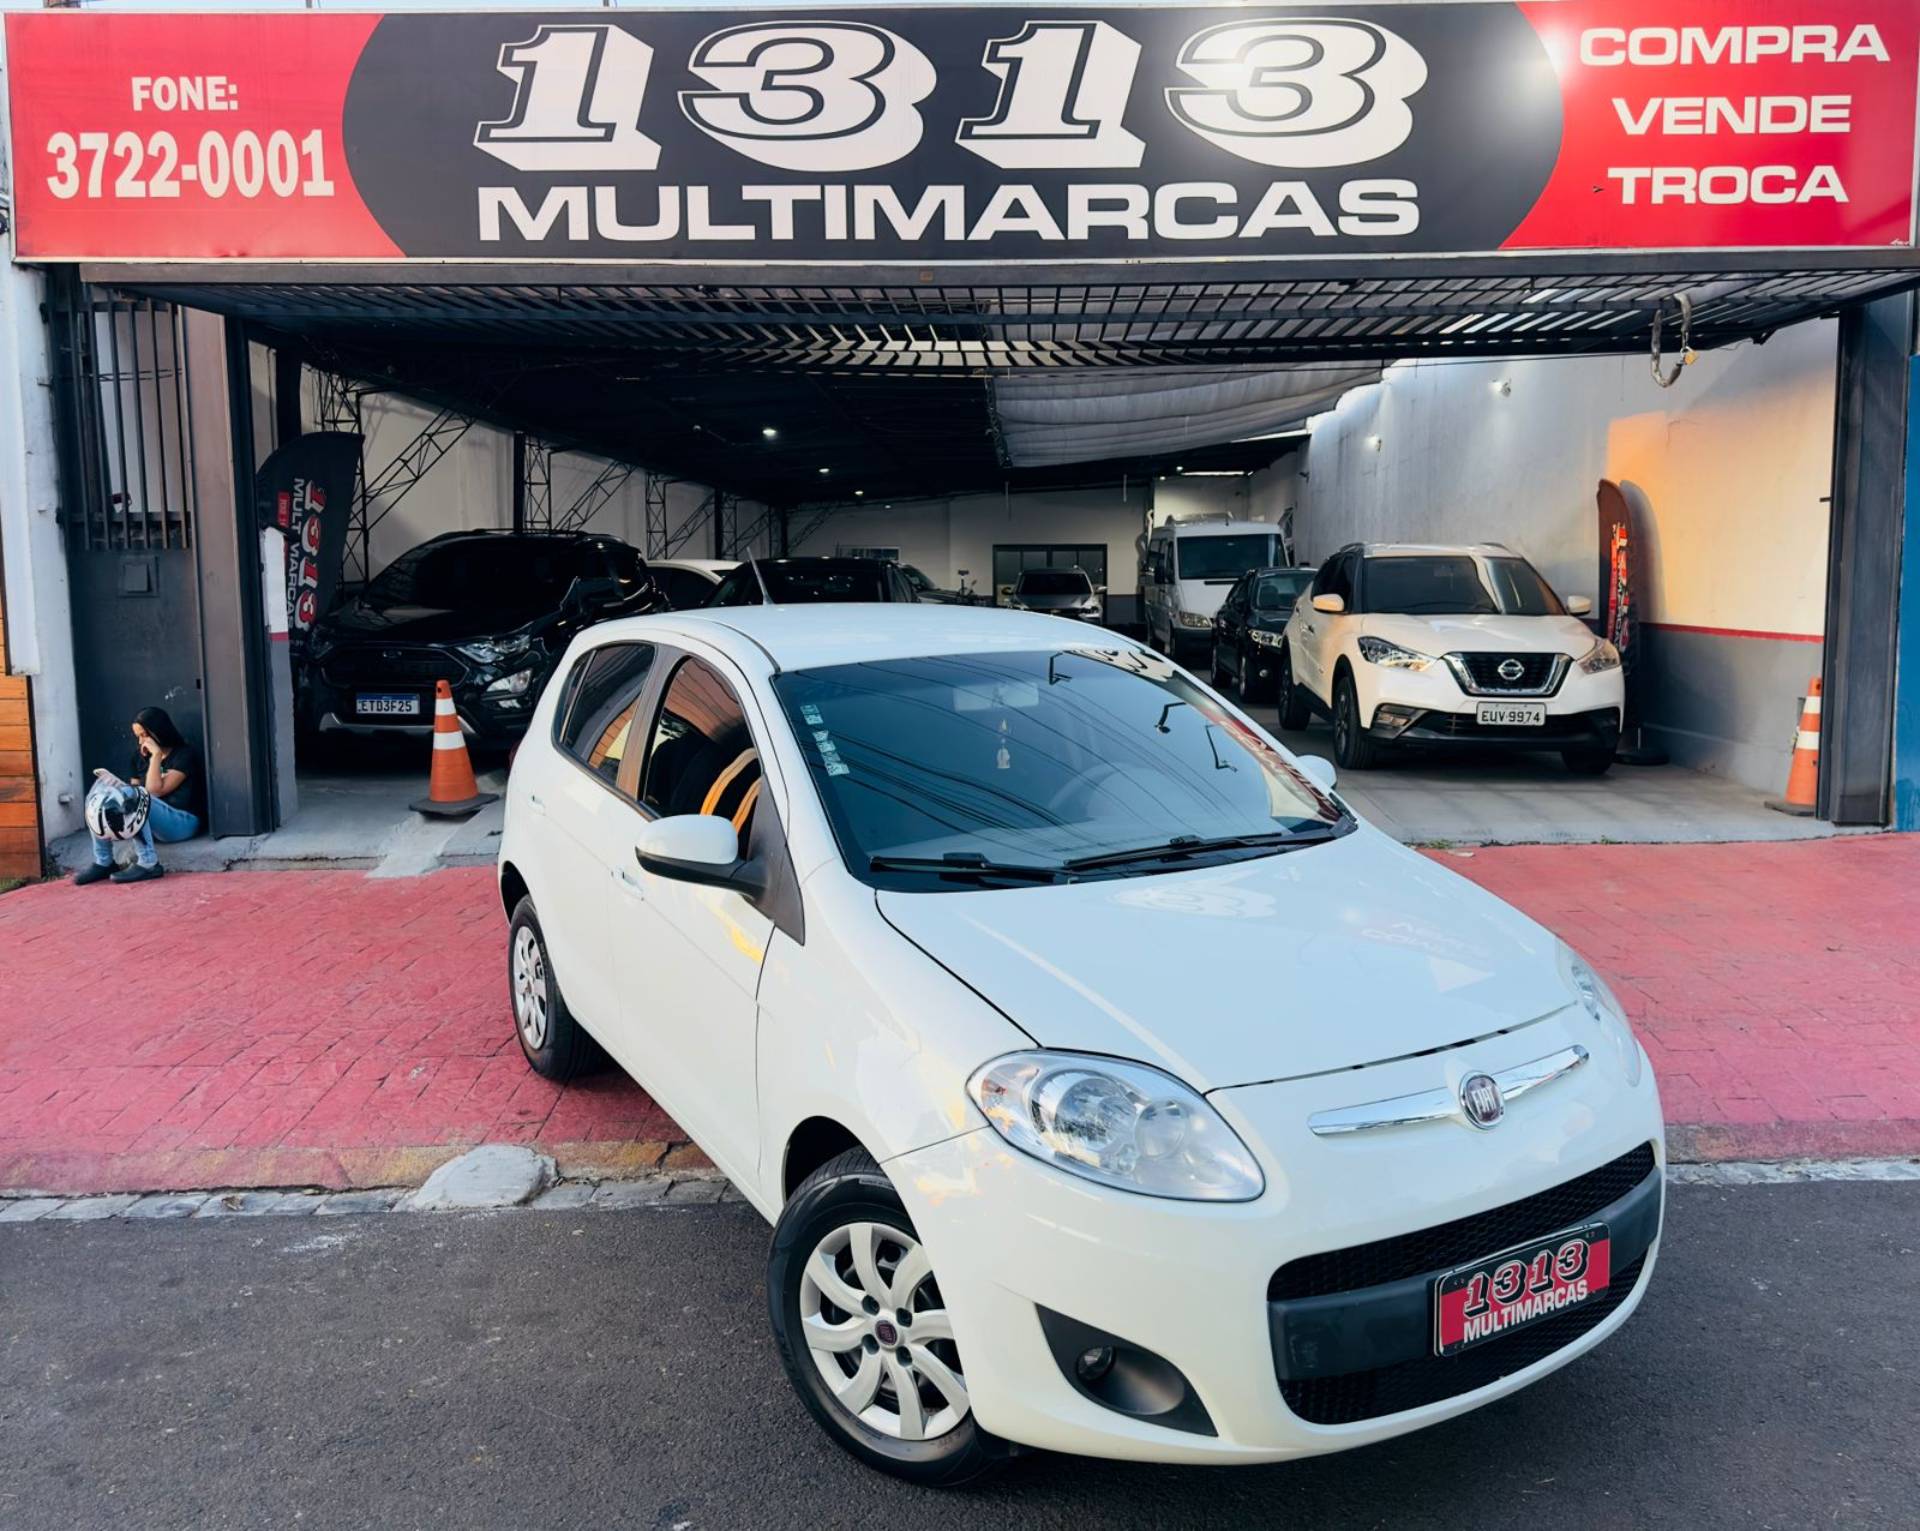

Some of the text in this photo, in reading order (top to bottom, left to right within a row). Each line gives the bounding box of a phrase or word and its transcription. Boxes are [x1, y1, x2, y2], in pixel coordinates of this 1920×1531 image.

[1580, 24, 1891, 66] COMPRA
[131, 76, 239, 112] FONE:
[473, 17, 1428, 172] 1313
[1612, 95, 1852, 135] VENDE
[46, 129, 335, 199] 3722-0001
[1608, 165, 1850, 205] TROCA
[478, 179, 1420, 242] MULTIMARCAS
[295, 480, 326, 632] 1313
[1470, 1086, 1499, 1113] FIAT
[1463, 1238, 1590, 1320] 1313
[1463, 1279, 1588, 1344] MULTIMARCAS
